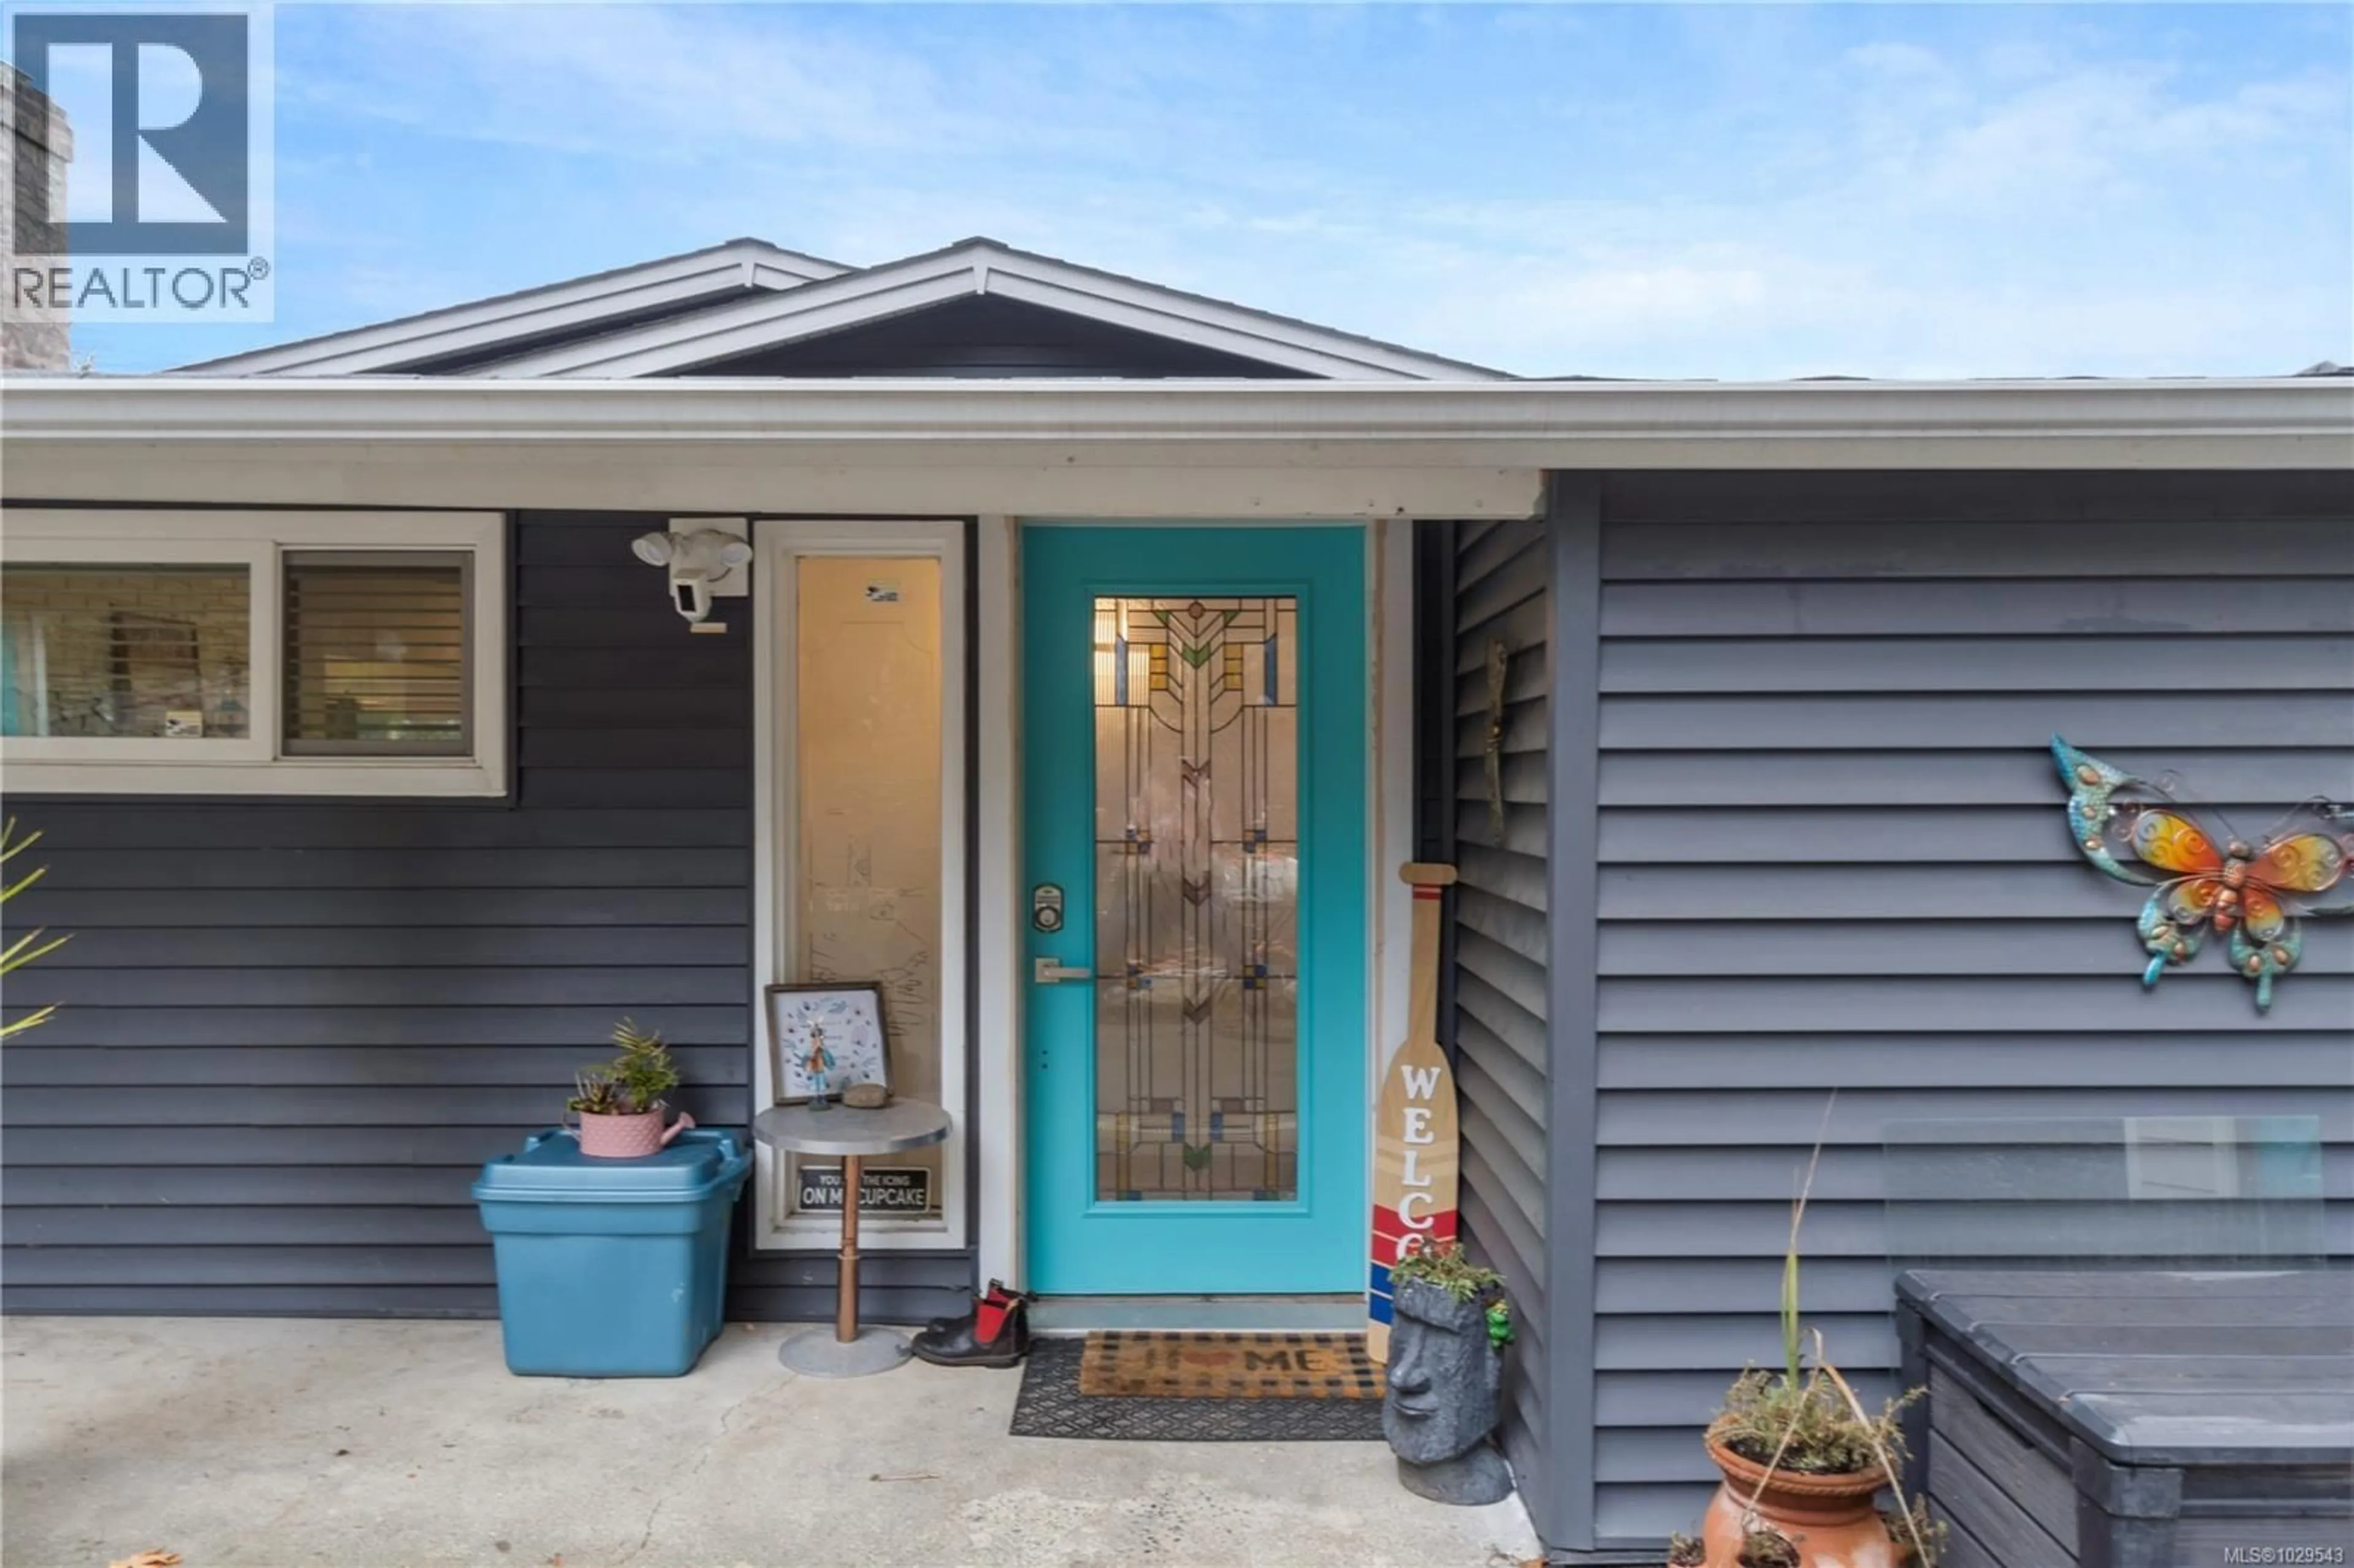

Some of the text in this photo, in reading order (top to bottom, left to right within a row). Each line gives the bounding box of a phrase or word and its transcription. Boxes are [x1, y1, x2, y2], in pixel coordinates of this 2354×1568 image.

[1396, 1065, 1441, 1261] WELCO
[863, 1174, 880, 1186] THE
[883, 1174, 910, 1186] ICING
[803, 1187, 925, 1205] ON M CUPCAKE
